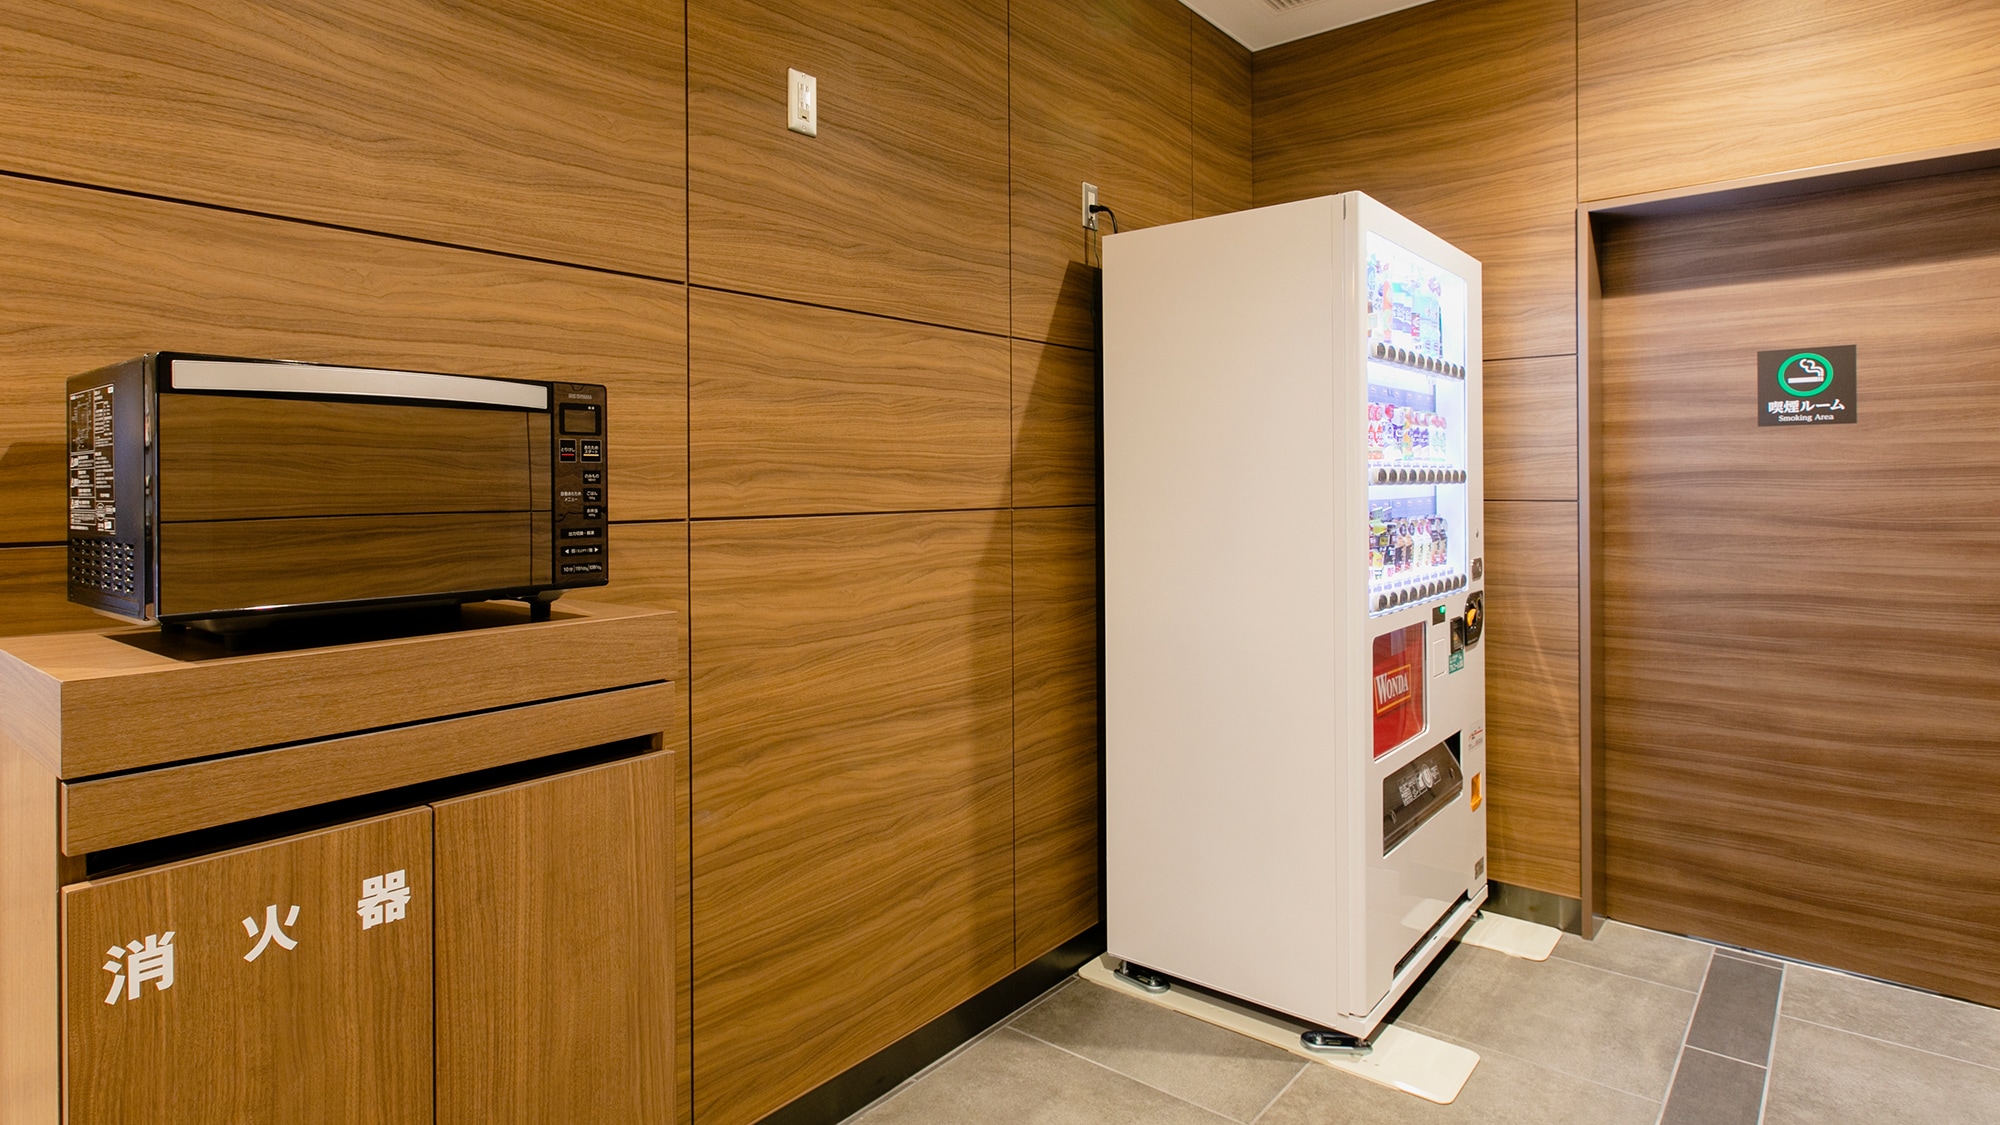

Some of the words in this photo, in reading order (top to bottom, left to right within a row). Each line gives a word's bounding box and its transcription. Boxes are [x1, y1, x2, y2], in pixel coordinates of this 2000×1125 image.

[1768, 399, 1845, 414] 喫煙ルーム
[1778, 414, 1813, 423] Smoking
[1814, 413, 1835, 421] Area
[1375, 672, 1409, 705] WONDA
[102, 869, 411, 1006] 消火器
